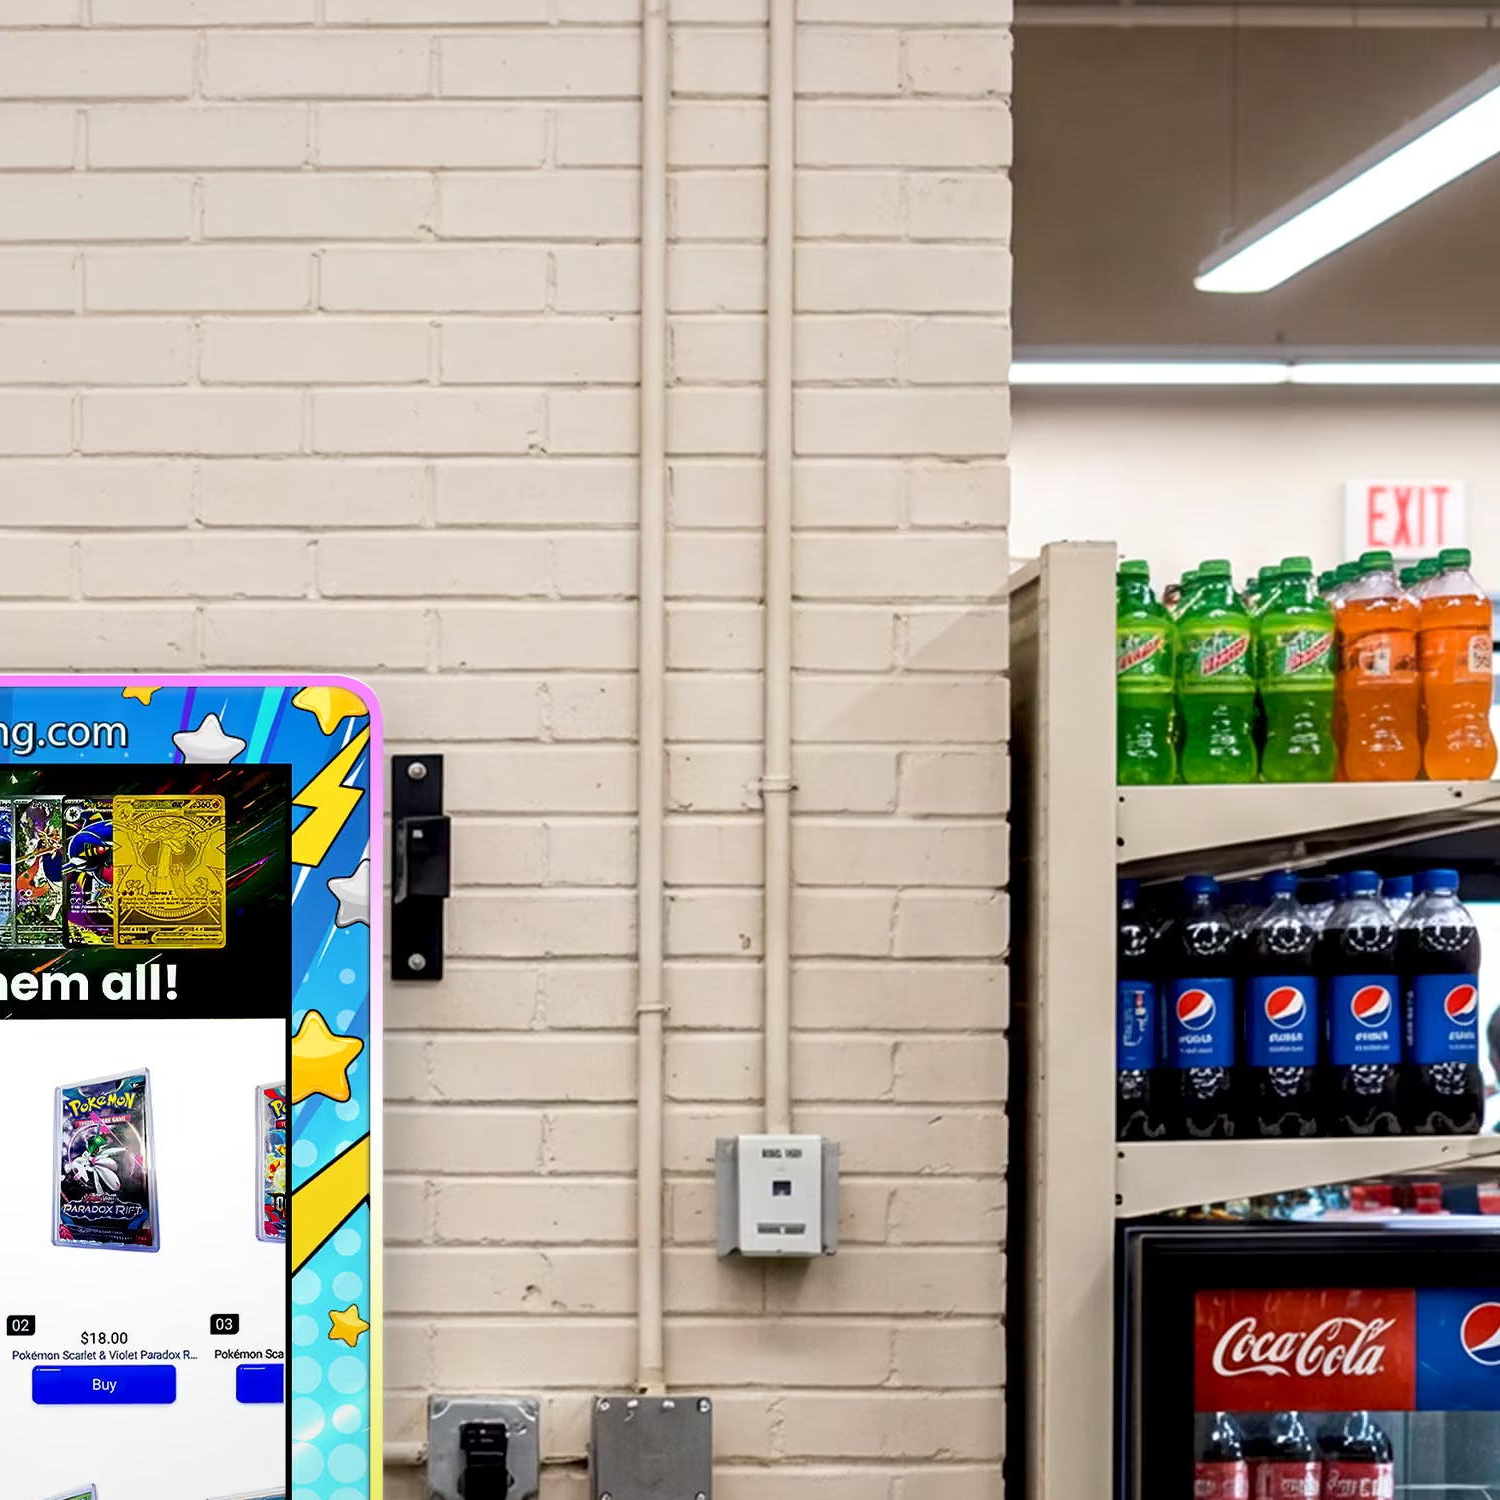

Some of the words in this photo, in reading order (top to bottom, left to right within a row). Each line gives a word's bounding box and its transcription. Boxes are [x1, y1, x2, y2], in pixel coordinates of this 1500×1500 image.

[1366, 485, 1449, 547] EXIT
[101, 963, 179, 1002] all!
[63, 1203, 113, 1215] PARADOX
[11, 1318, 30, 1332] 02
[215, 1317, 233, 1331] 03
[80, 1330, 129, 1345] $18.00
[1212, 1315, 1397, 1378] Coca-Cola
[11, 1349, 60, 1361] Pokémon
[62, 1350, 97, 1361] Scarlet
[99, 1350, 107, 1360] &
[108, 1350, 138, 1360] Violet
[140, 1350, 181, 1360] Paradox
[183, 1350, 198, 1360] R...
[214, 1348, 263, 1360] Pokémon
[92, 1378, 117, 1393] Buy
